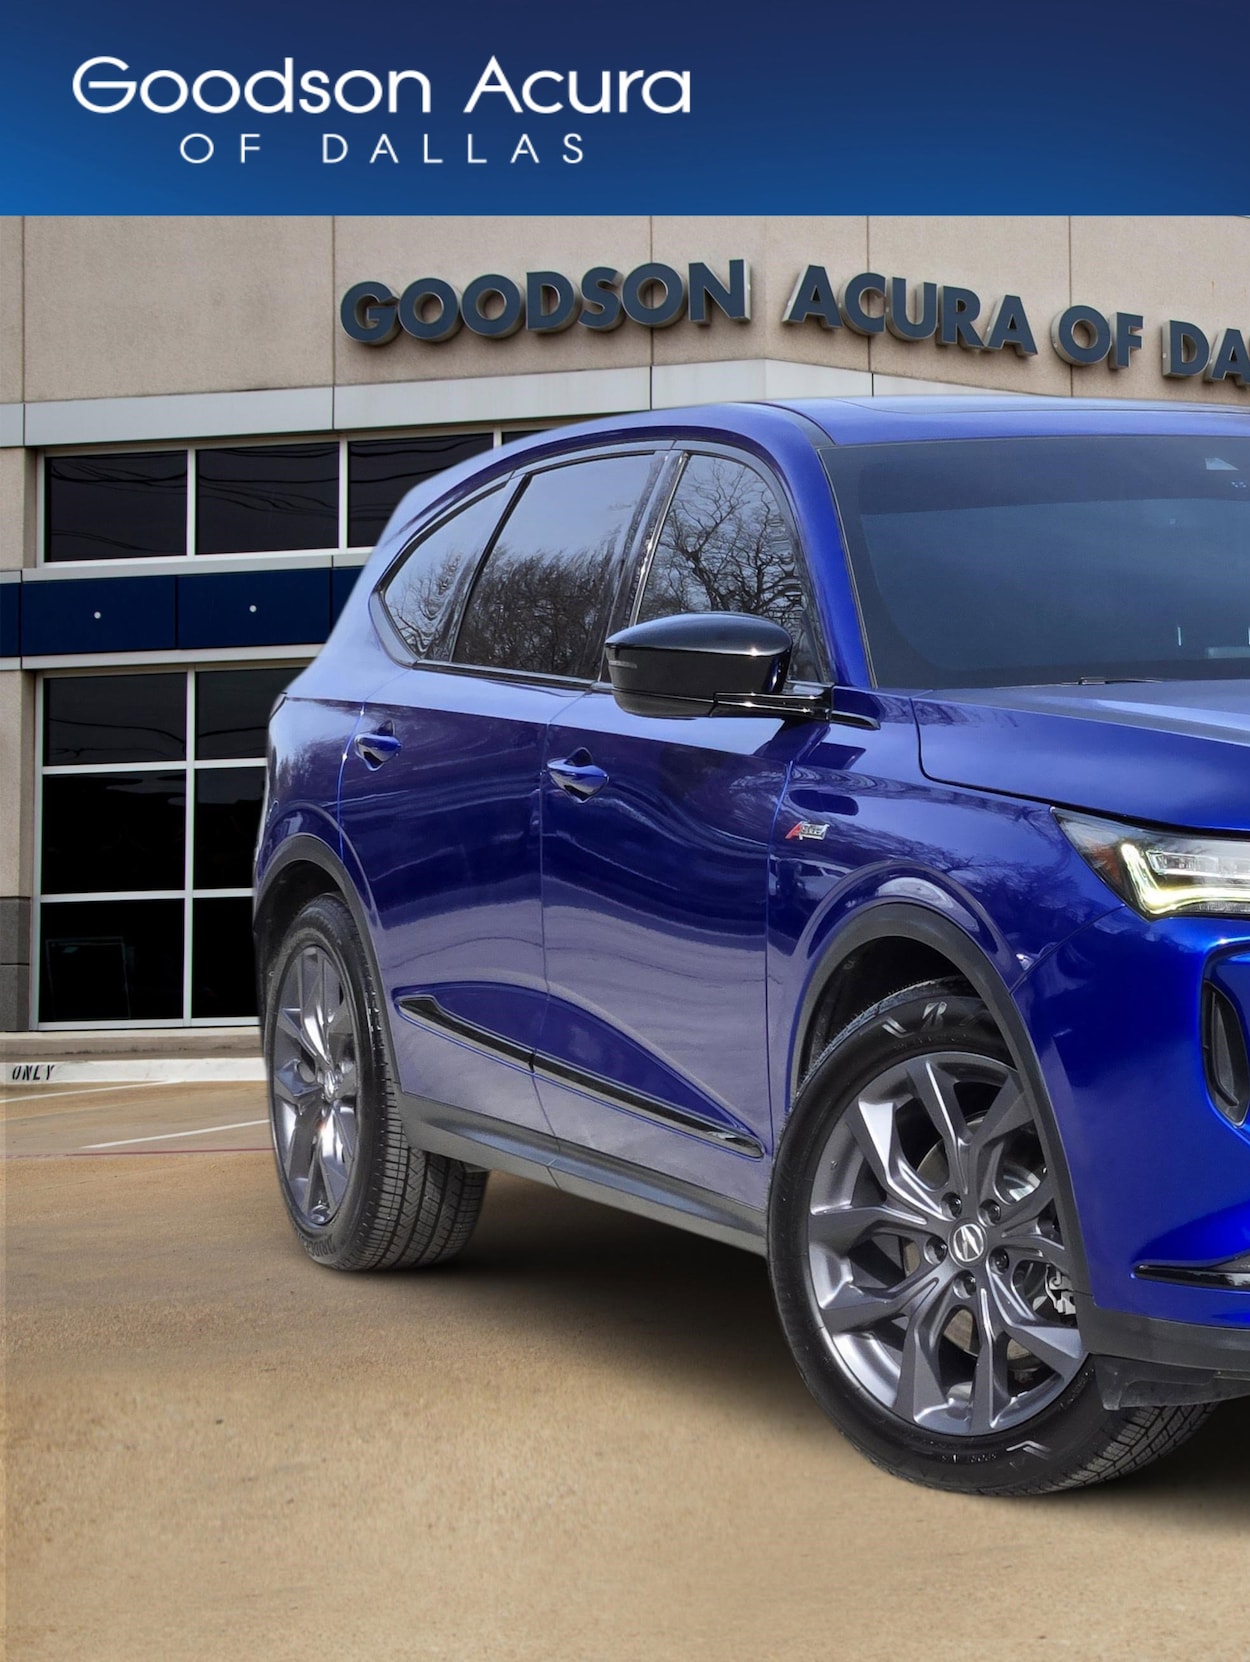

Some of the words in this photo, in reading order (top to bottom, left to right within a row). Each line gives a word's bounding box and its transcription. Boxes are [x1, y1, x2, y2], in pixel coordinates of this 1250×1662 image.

[340, 259, 752, 346] GOODSON
[783, 264, 1038, 357] ACURA
[1051, 305, 1144, 371] OF
[12, 1064, 55, 1080] ONLY
